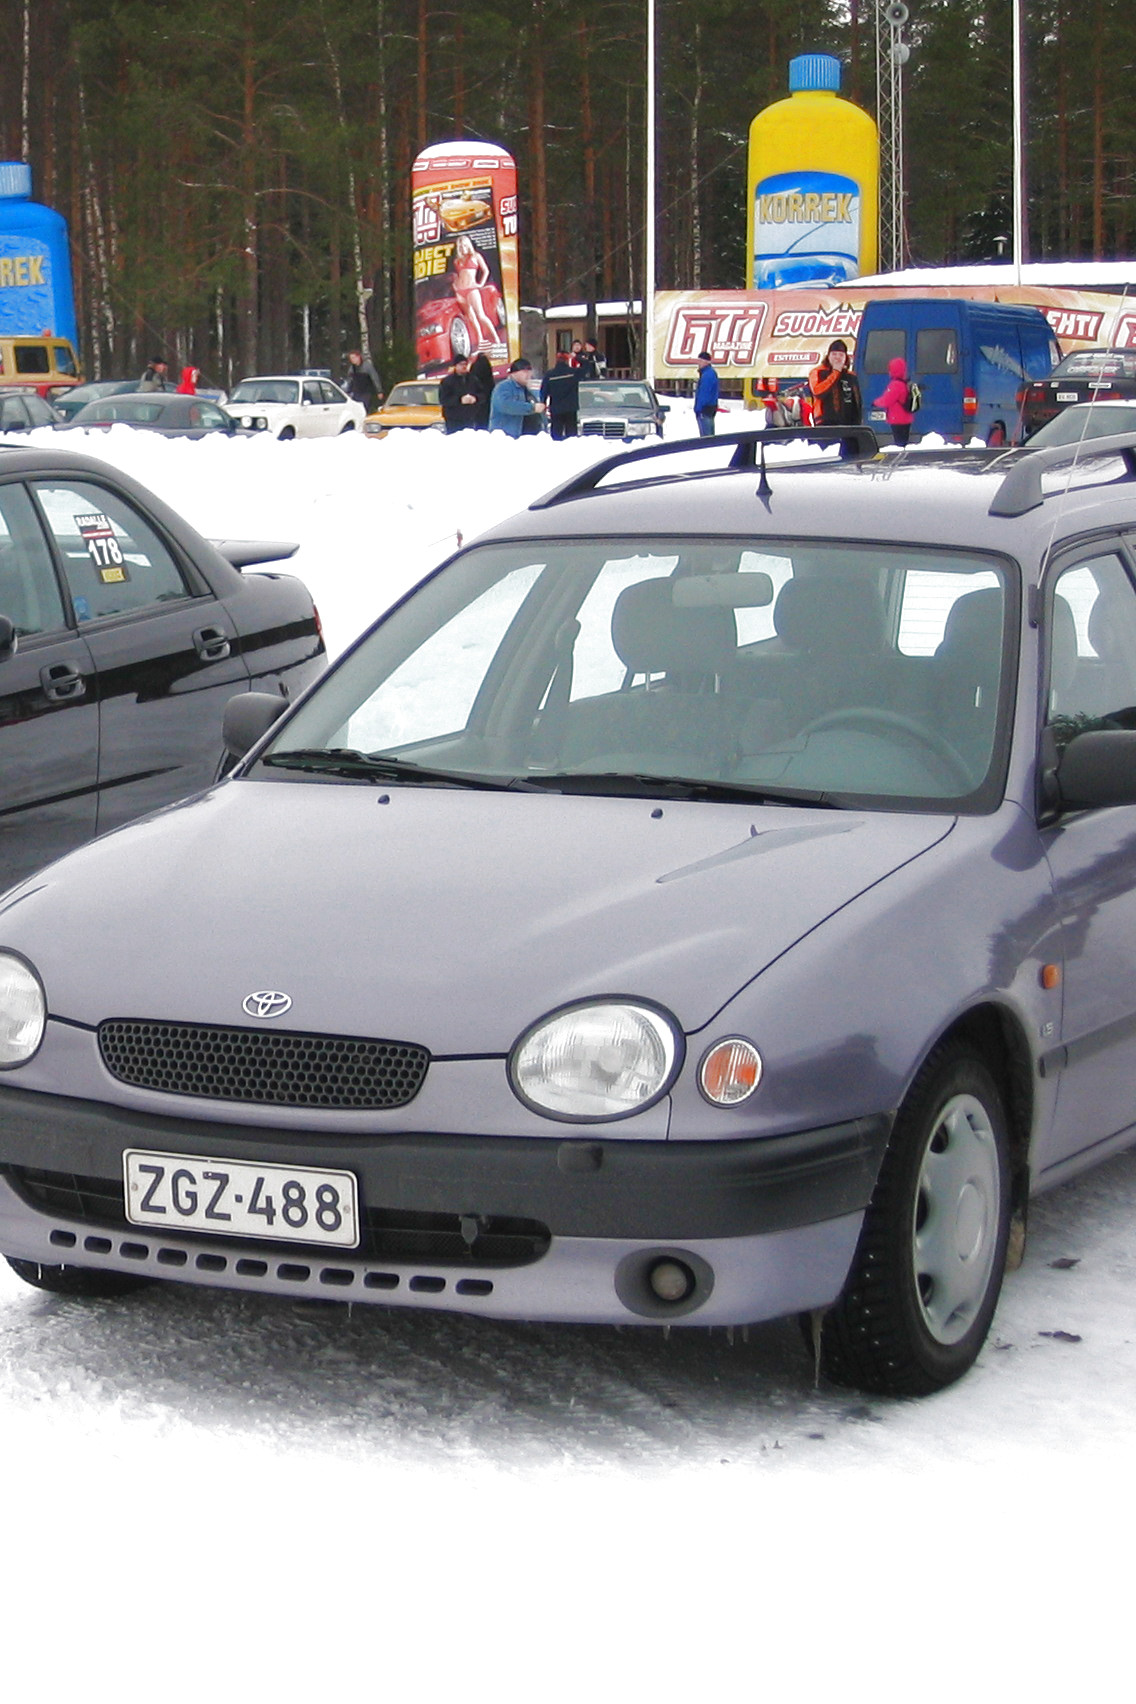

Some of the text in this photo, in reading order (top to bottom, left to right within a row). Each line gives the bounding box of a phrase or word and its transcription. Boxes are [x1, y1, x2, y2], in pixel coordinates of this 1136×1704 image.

[760, 193, 853, 224] KORREK
[777, 311, 863, 334] SUOMEN
[1038, 309, 1099, 338] EHTI
[88, 538, 123, 566] 178
